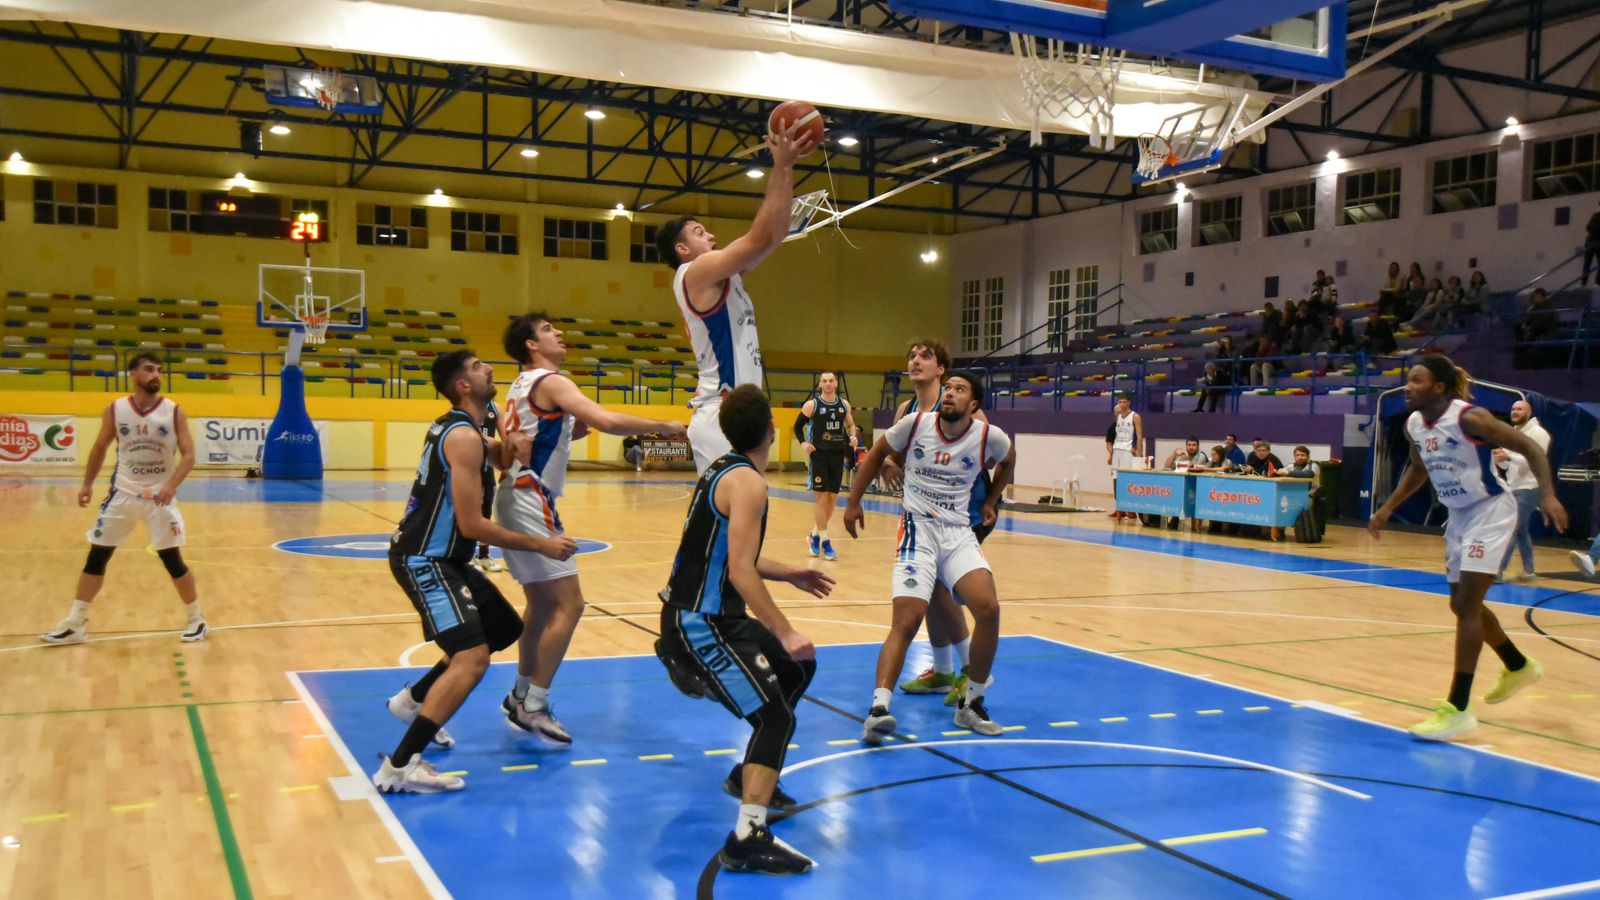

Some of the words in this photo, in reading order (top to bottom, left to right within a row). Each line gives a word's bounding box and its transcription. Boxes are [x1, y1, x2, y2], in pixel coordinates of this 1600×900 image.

[291, 222, 318, 240] 24
[135, 424, 148, 435] 14
[826, 421, 840, 430] ULB
[1425, 437, 1439, 453] 25
[933, 450, 951, 466] 10
[132, 467, 166, 475] OCHOA
[920, 488, 956, 501] Hospital
[1127, 480, 1171, 497] deportes
[1209, 487, 1261, 505] deportes
[1468, 545, 1485, 558] 25
